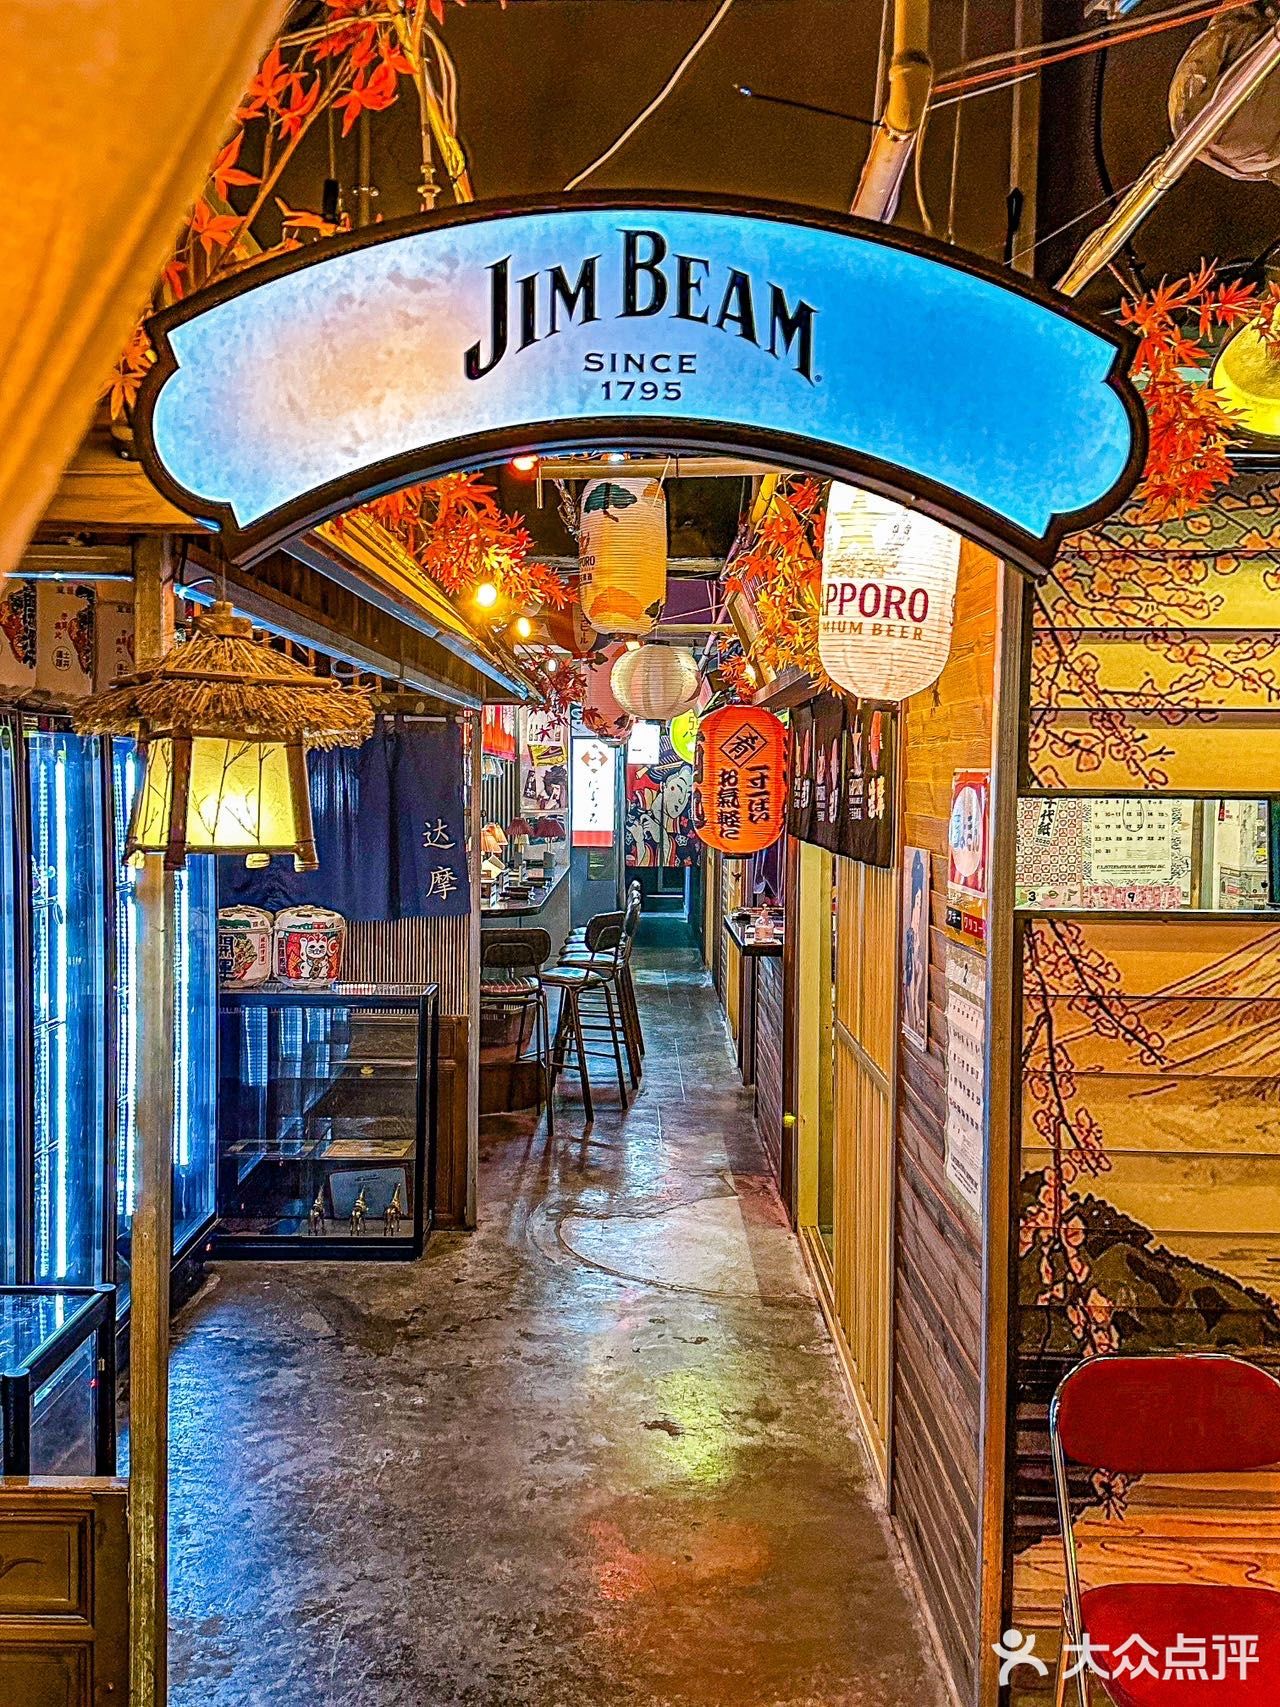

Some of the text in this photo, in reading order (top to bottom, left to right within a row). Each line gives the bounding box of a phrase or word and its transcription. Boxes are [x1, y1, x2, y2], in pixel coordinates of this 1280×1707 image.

[464, 228, 820, 388] JIM BEAM
[583, 352, 698, 375] SINCE
[600, 380, 683, 401] 1795
[871, 623, 924, 640] BEER
[422, 818, 458, 900] 达摩
